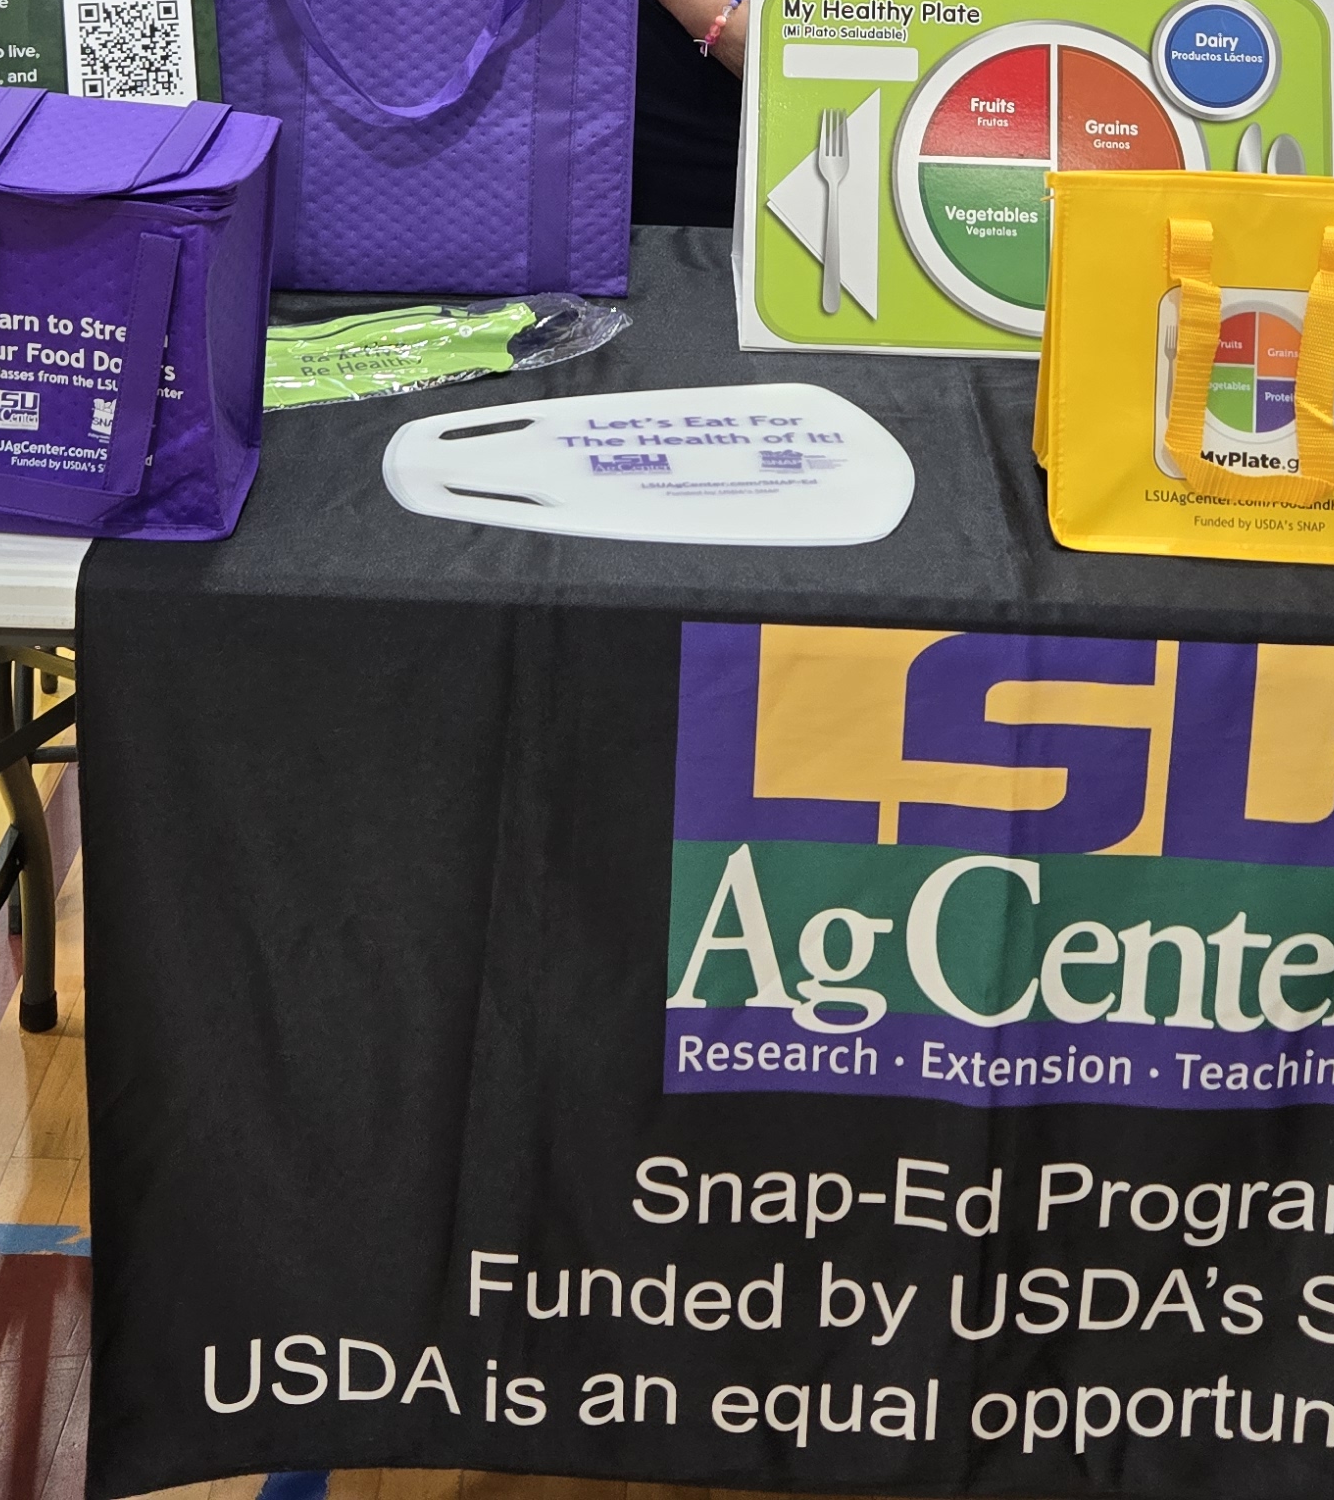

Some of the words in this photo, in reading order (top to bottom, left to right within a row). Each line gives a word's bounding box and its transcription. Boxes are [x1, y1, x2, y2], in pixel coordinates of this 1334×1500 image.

[821, 0, 913, 24] Healthy
[921, 1, 981, 23] Plate
[783, 26, 800, 39] (Mi
[802, 26, 836, 38] Plato
[839, 27, 907, 42] Saludable)
[1195, 32, 1238, 51] Dairy
[8, 45, 41, 61] live,
[1171, 51, 1221, 63] Productos
[1223, 51, 1263, 64] Lácteos
[8, 69, 38, 83] and
[970, 98, 1016, 116] Fruits
[977, 116, 1009, 128] Frutas
[1085, 120, 1139, 137] Grains
[1093, 140, 1131, 151] Granos
[945, 206, 1039, 226] Vegetables
[965, 226, 1017, 238] Vegetales
[48, 316, 73, 334] to
[26, 343, 85, 369] Food
[1267, 348, 1298, 358] Grains
[38, 371, 69, 385] from
[73, 374, 94, 388] the
[588, 417, 673, 430] Let's
[684, 416, 739, 428] Eat
[749, 414, 803, 427] For
[558, 436, 626, 448] The
[638, 432, 752, 447] Health
[763, 432, 795, 444] of
[807, 432, 844, 444] It!
[1194, 515, 1235, 528] Funded
[1238, 516, 1251, 532] by
[1255, 518, 1294, 531] USDA's
[1297, 520, 1326, 532] SNAP
[677, 1034, 878, 1076] Research
[921, 1041, 1132, 1088] Extension
[632, 1155, 1004, 1239] Snap-Ed
[469, 1250, 784, 1331] Funded
[821, 1262, 917, 1347] by
[950, 1266, 1265, 1340] USDA's
[202, 1334, 462, 1415] USDA
[484, 1360, 548, 1426] is
[578, 1372, 678, 1425] an
[711, 1378, 938, 1448] equal
